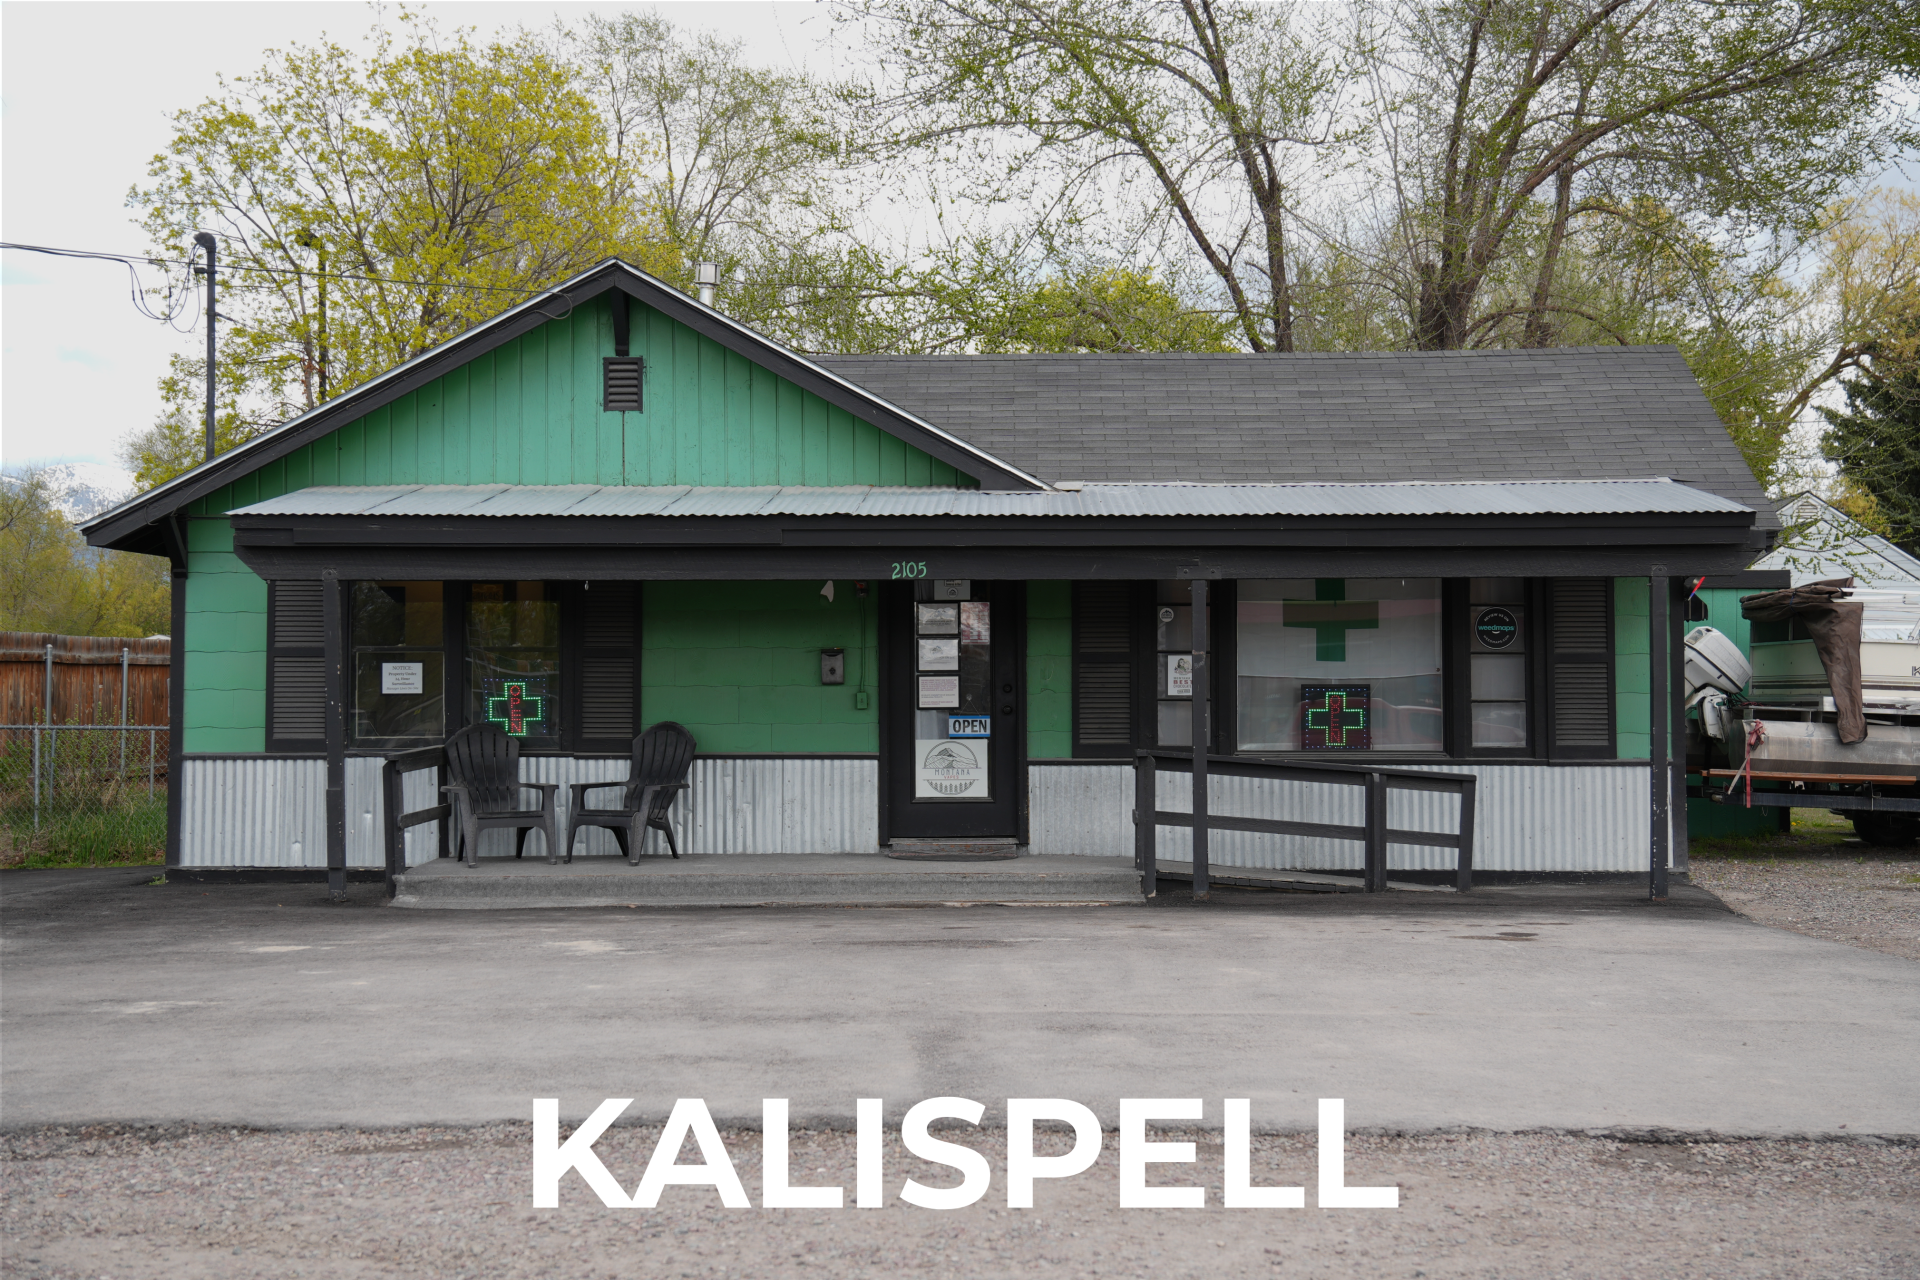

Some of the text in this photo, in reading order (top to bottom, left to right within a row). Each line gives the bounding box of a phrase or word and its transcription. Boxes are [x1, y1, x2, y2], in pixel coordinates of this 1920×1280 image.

[891, 560, 927, 580] 2105
[1478, 624, 1515, 632] weedmaps
[509, 684, 522, 733] OPEN
[952, 719, 987, 733] OPEN
[1329, 694, 1341, 743] OPEN
[934, 768, 970, 776] MONTANA
